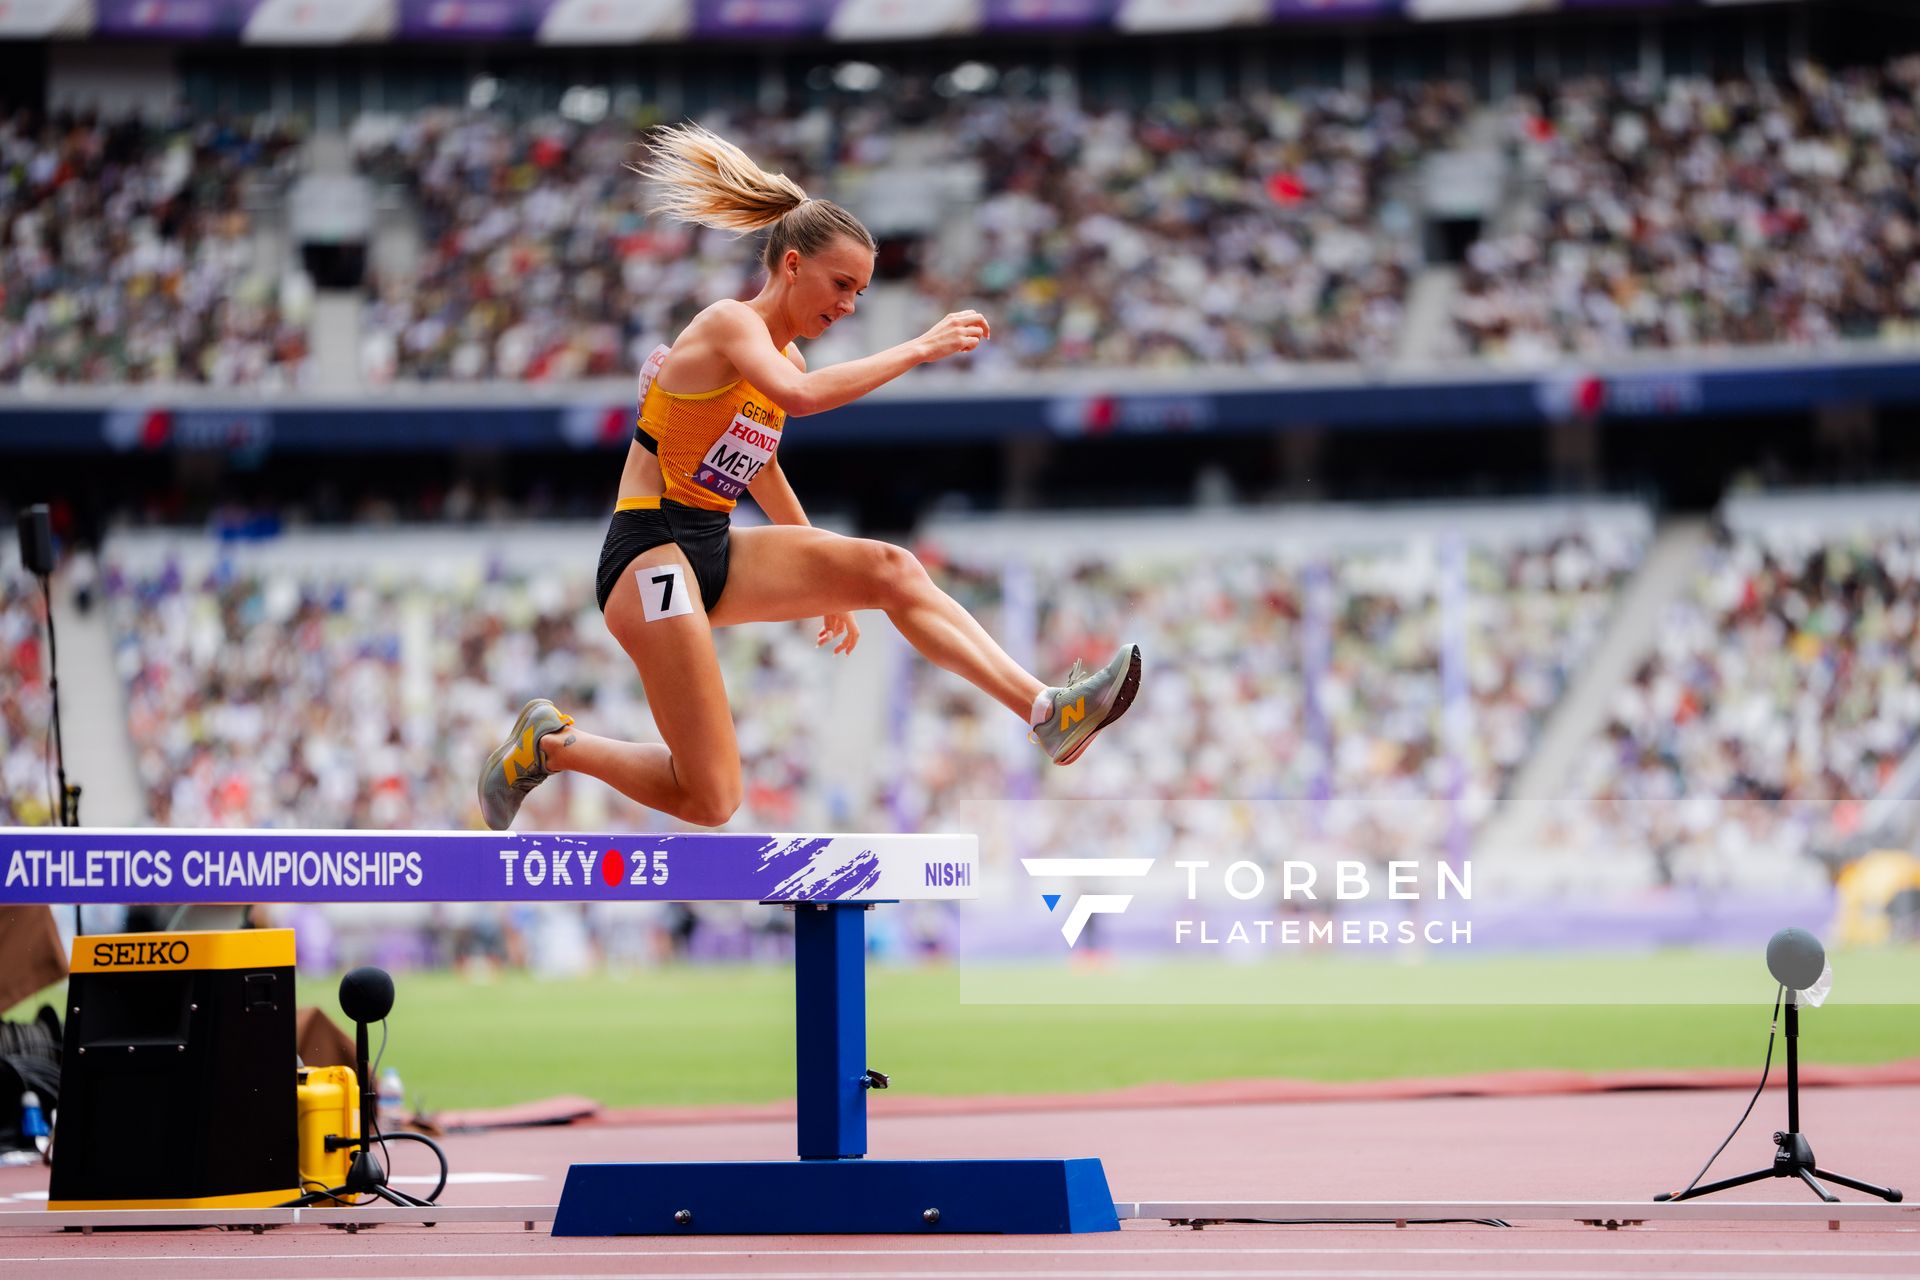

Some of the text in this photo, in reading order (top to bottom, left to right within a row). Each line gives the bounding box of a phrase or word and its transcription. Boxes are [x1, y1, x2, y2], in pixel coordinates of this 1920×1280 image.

[651, 573, 675, 612] 7
[5, 850, 423, 887] ATHLETICS CHAMPIONSHIPS
[925, 862, 970, 886] NISHI
[93, 941, 189, 966] SEIKO
